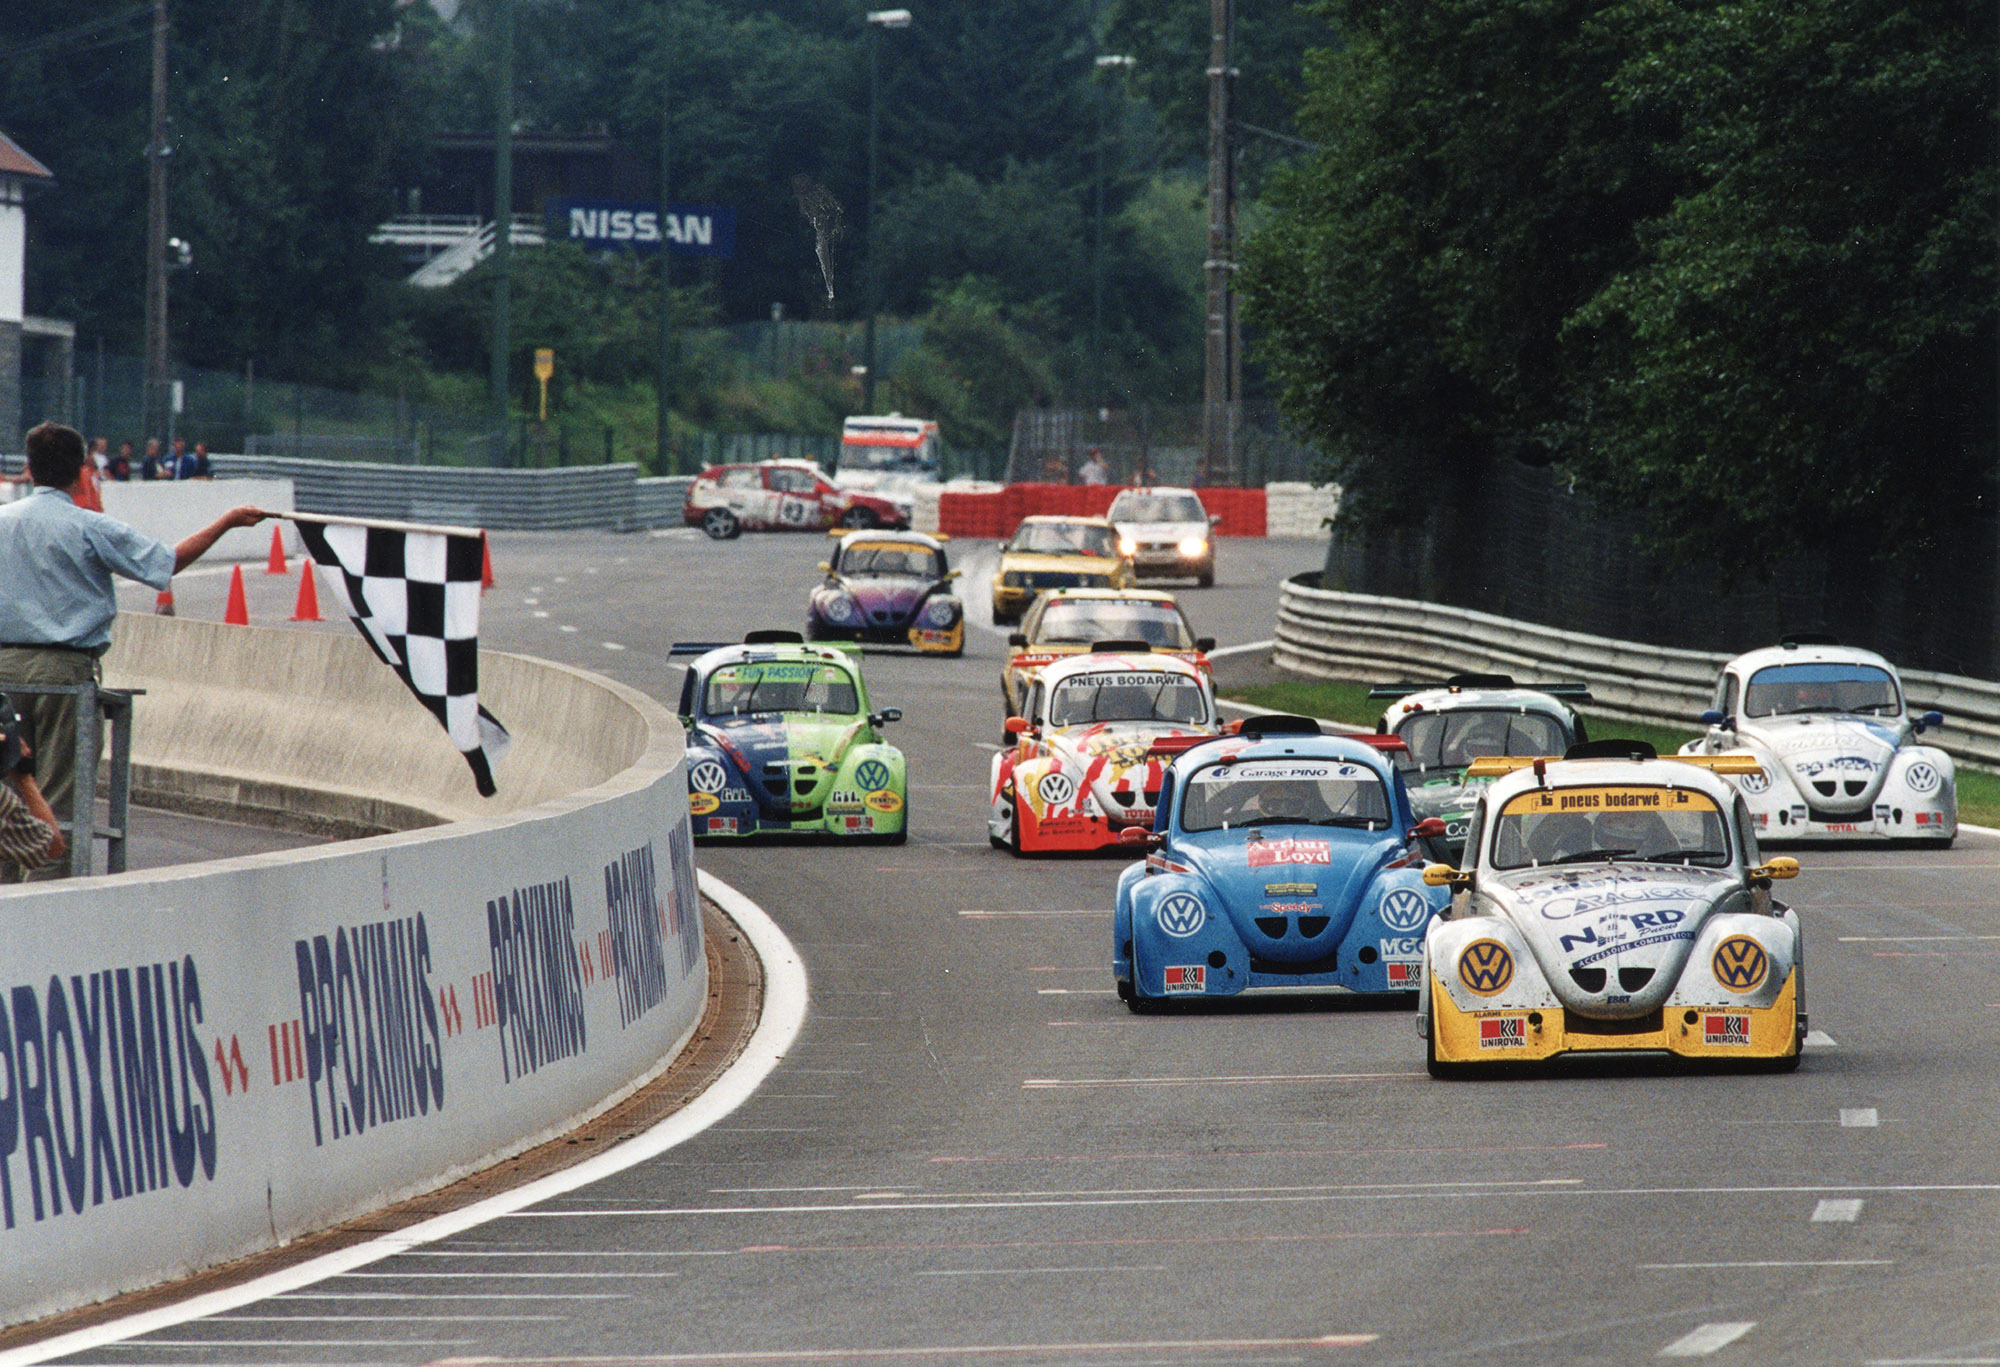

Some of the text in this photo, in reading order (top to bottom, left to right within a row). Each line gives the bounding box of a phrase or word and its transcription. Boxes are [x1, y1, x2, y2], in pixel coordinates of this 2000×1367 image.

[570, 208, 712, 245] NISSAN
[1069, 674, 1185, 687] PNEUS BODARWE
[1240, 768, 1329, 779] Garage PINO
[1561, 794, 1600, 810] pneus
[1605, 791, 1660, 807] bodarwé
[1446, 822, 1469, 836] Co
[1825, 824, 1858, 833] TOTAL
[1248, 838, 1329, 851] Arthur
[1274, 850, 1330, 865] Loyd
[1271, 901, 1312, 917] Speedy
[1638, 921, 1679, 937] Pneus
[1578, 931, 1694, 968] ACCESSOIRE COMPETITION
[487, 876, 586, 1085] PROXIMUS
[1390, 980, 1420, 988] UNIROY
[1165, 983, 1204, 992] UNIROYAL
[1473, 1010, 1502, 1019] ALARME
[296, 910, 444, 1147] PROXIMUS
[1481, 1037, 1525, 1048] UNIROYAL
[1705, 1034, 1750, 1044] UNIROYAL
